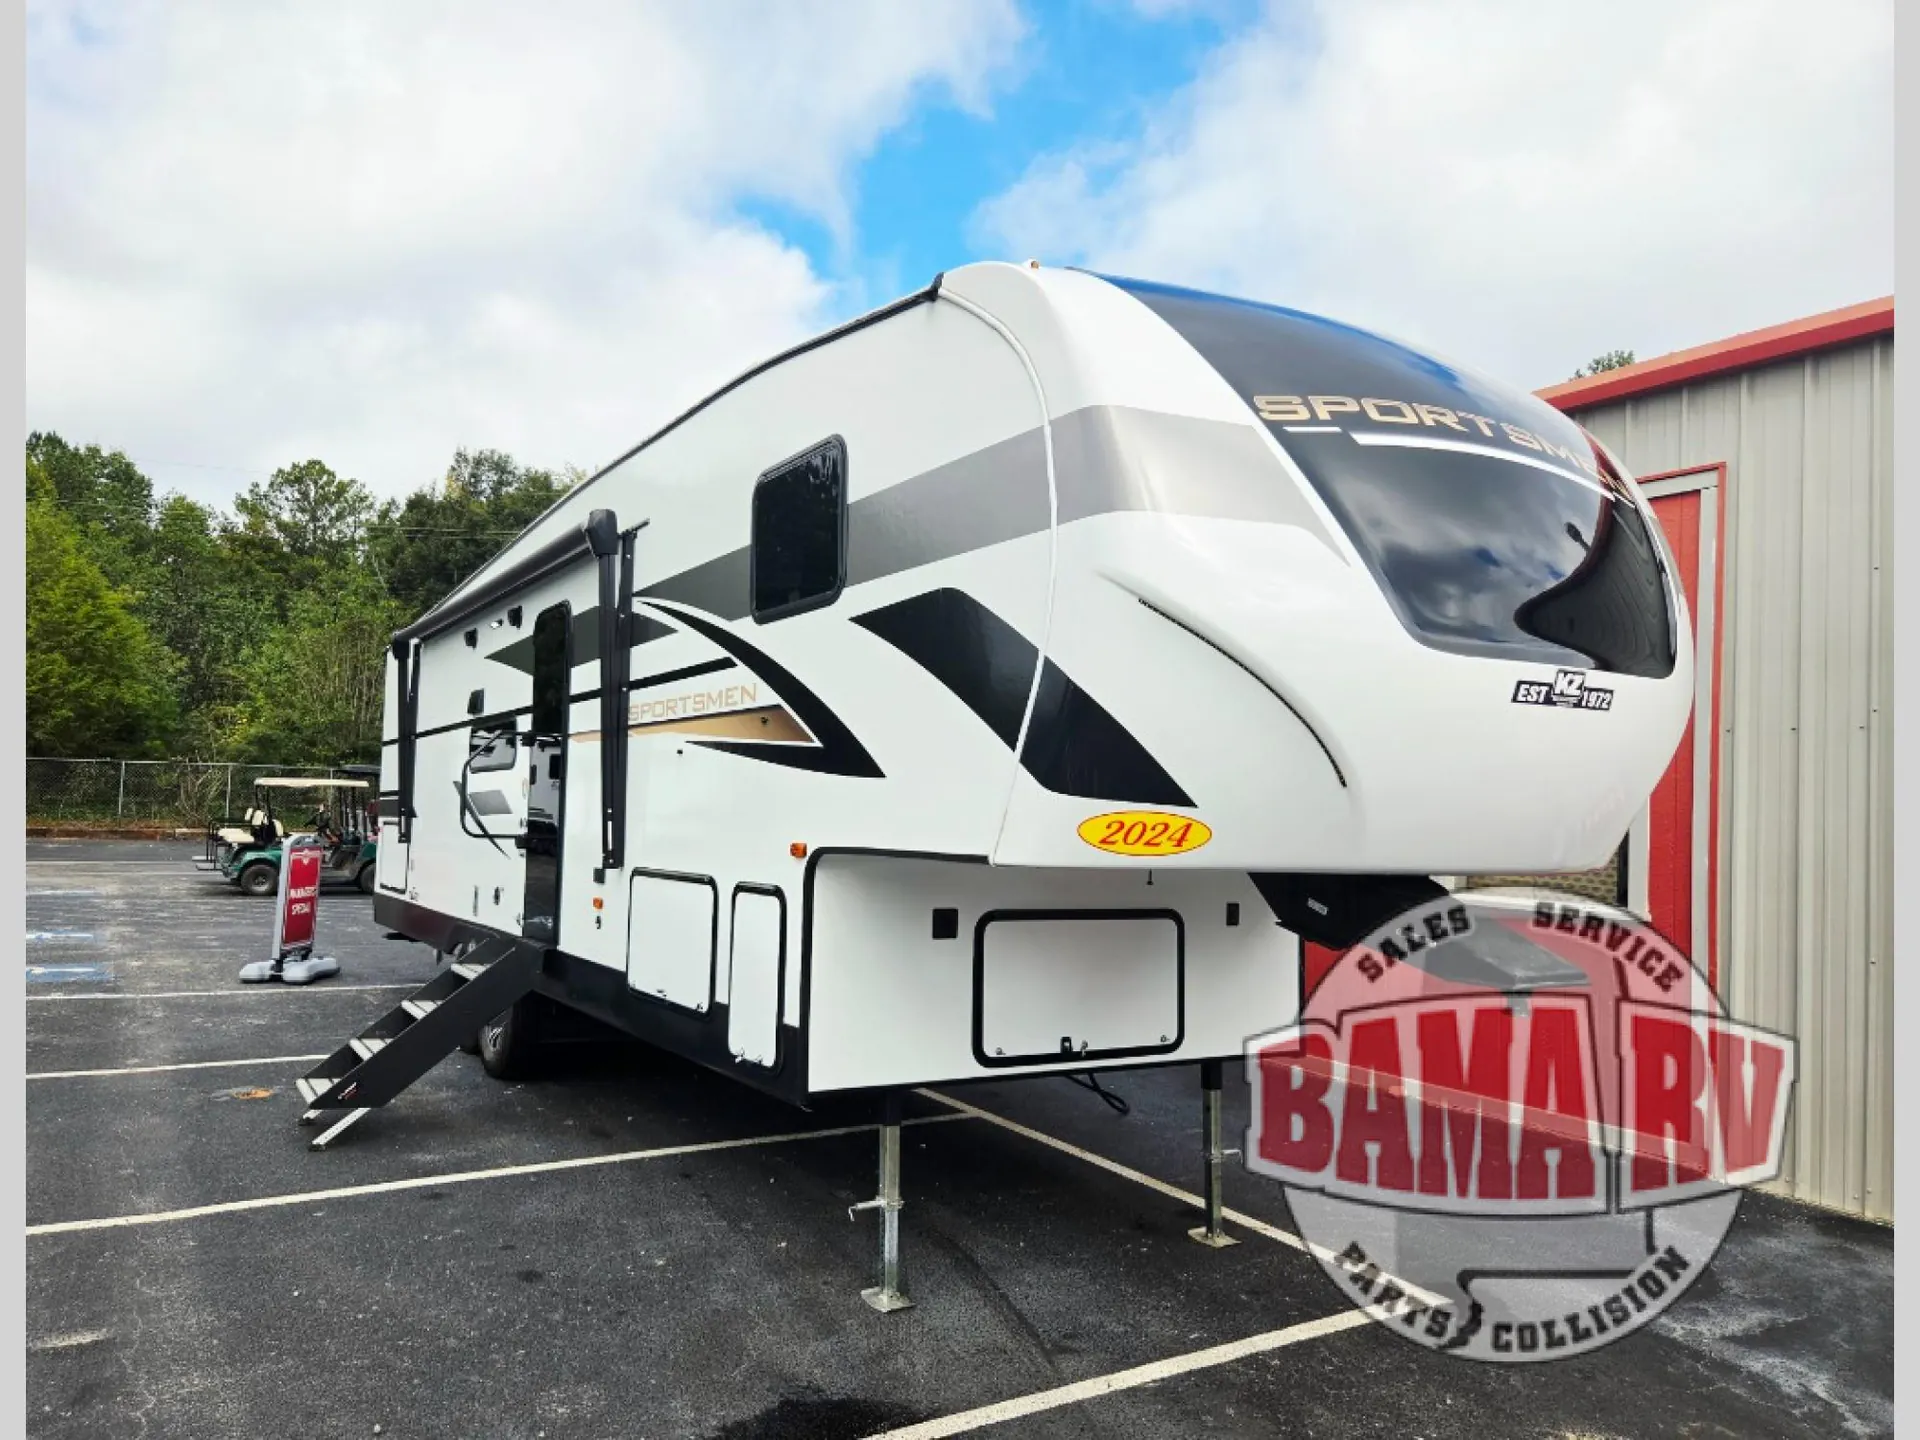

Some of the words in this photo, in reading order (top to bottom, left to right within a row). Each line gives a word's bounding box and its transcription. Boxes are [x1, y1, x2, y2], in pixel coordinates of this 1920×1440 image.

[1516, 683, 1549, 703] EST
[1581, 690, 1612, 709] 1972
[1554, 672, 1584, 696] KZ
[628, 682, 757, 721] SPORTSMEN
[1098, 819, 1193, 848] 2024
